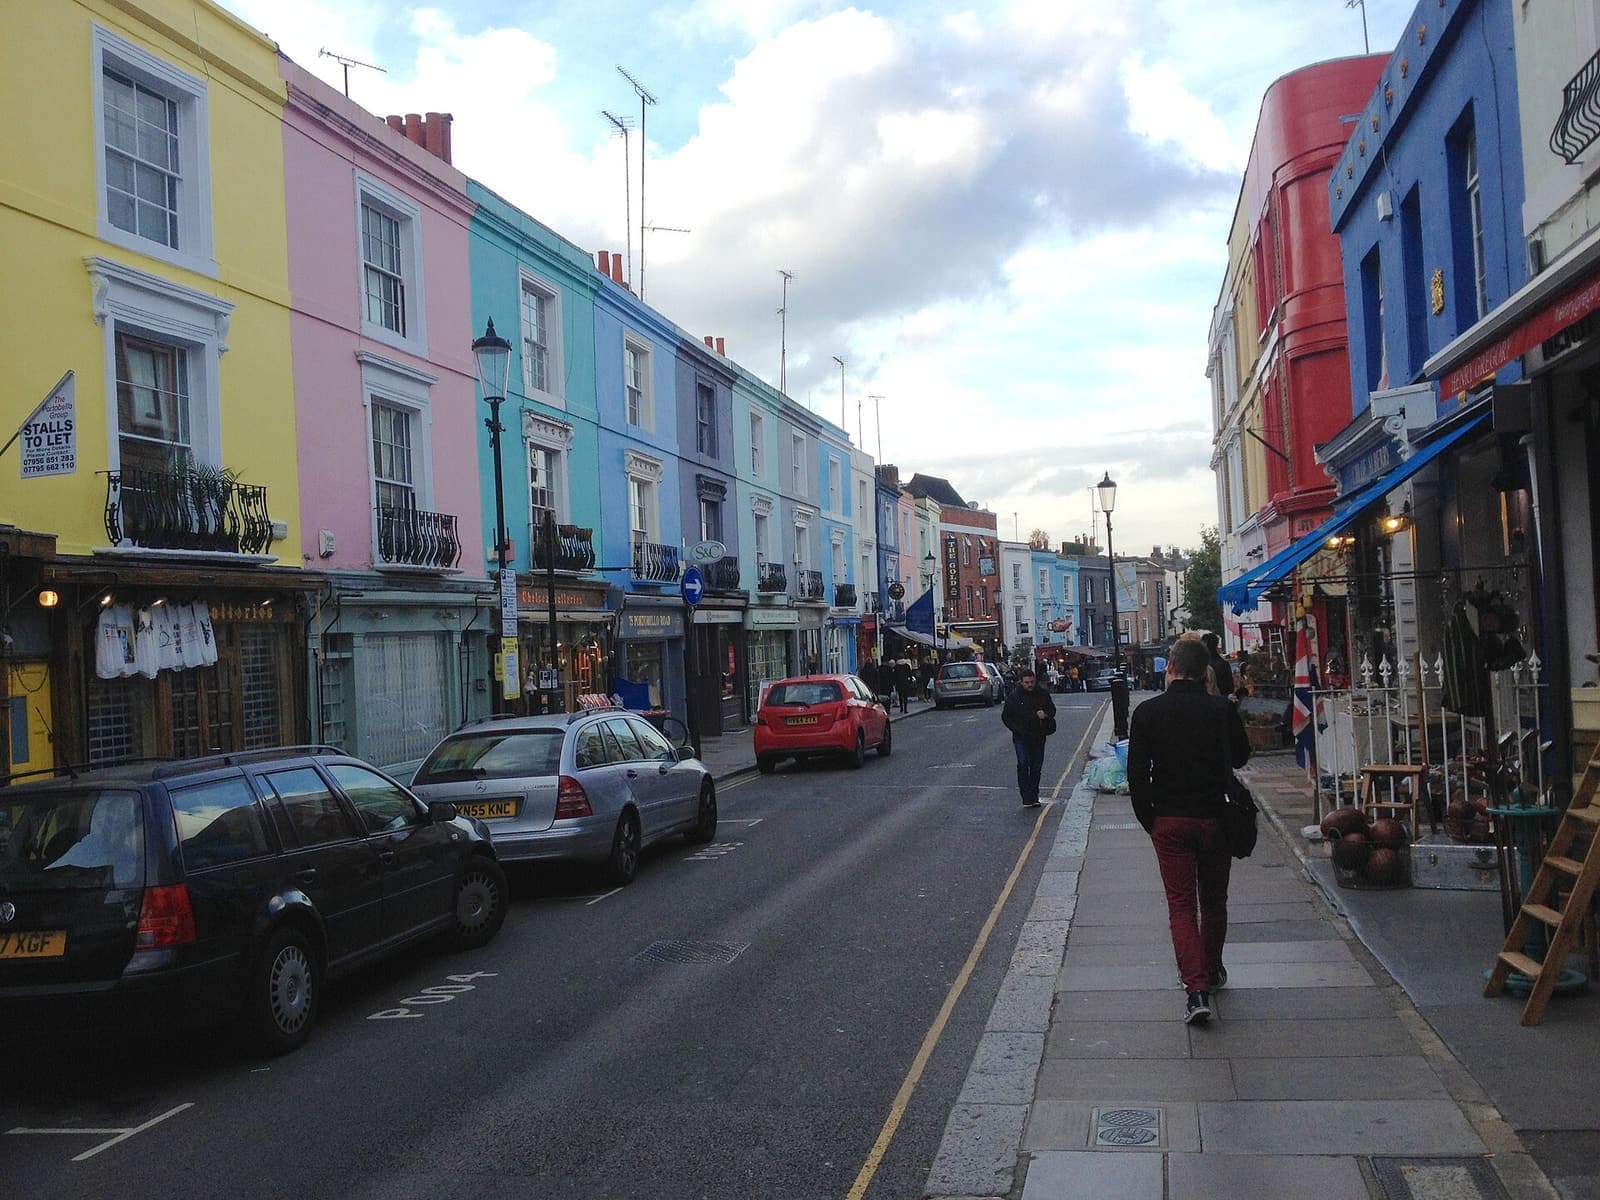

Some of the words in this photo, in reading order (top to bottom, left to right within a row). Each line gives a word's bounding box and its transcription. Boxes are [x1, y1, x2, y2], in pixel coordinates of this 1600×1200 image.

[49, 411, 69, 420] Group
[24, 419, 73, 436] STALLS
[24, 436, 43, 448] TO
[47, 433, 72, 446] LET
[24, 457, 45, 466] 07956
[60, 454, 74, 462] 283
[24, 465, 45, 474] 07795
[61, 461, 74, 469] 110
[695, 545, 720, 560] S&C
[948, 541, 956, 559] THE
[949, 562, 957, 586] GOLD
[456, 804, 486, 818] KN55
[488, 803, 511, 815] KNC
[14, 933, 54, 953] XGF
[366, 970, 499, 1020] P004
